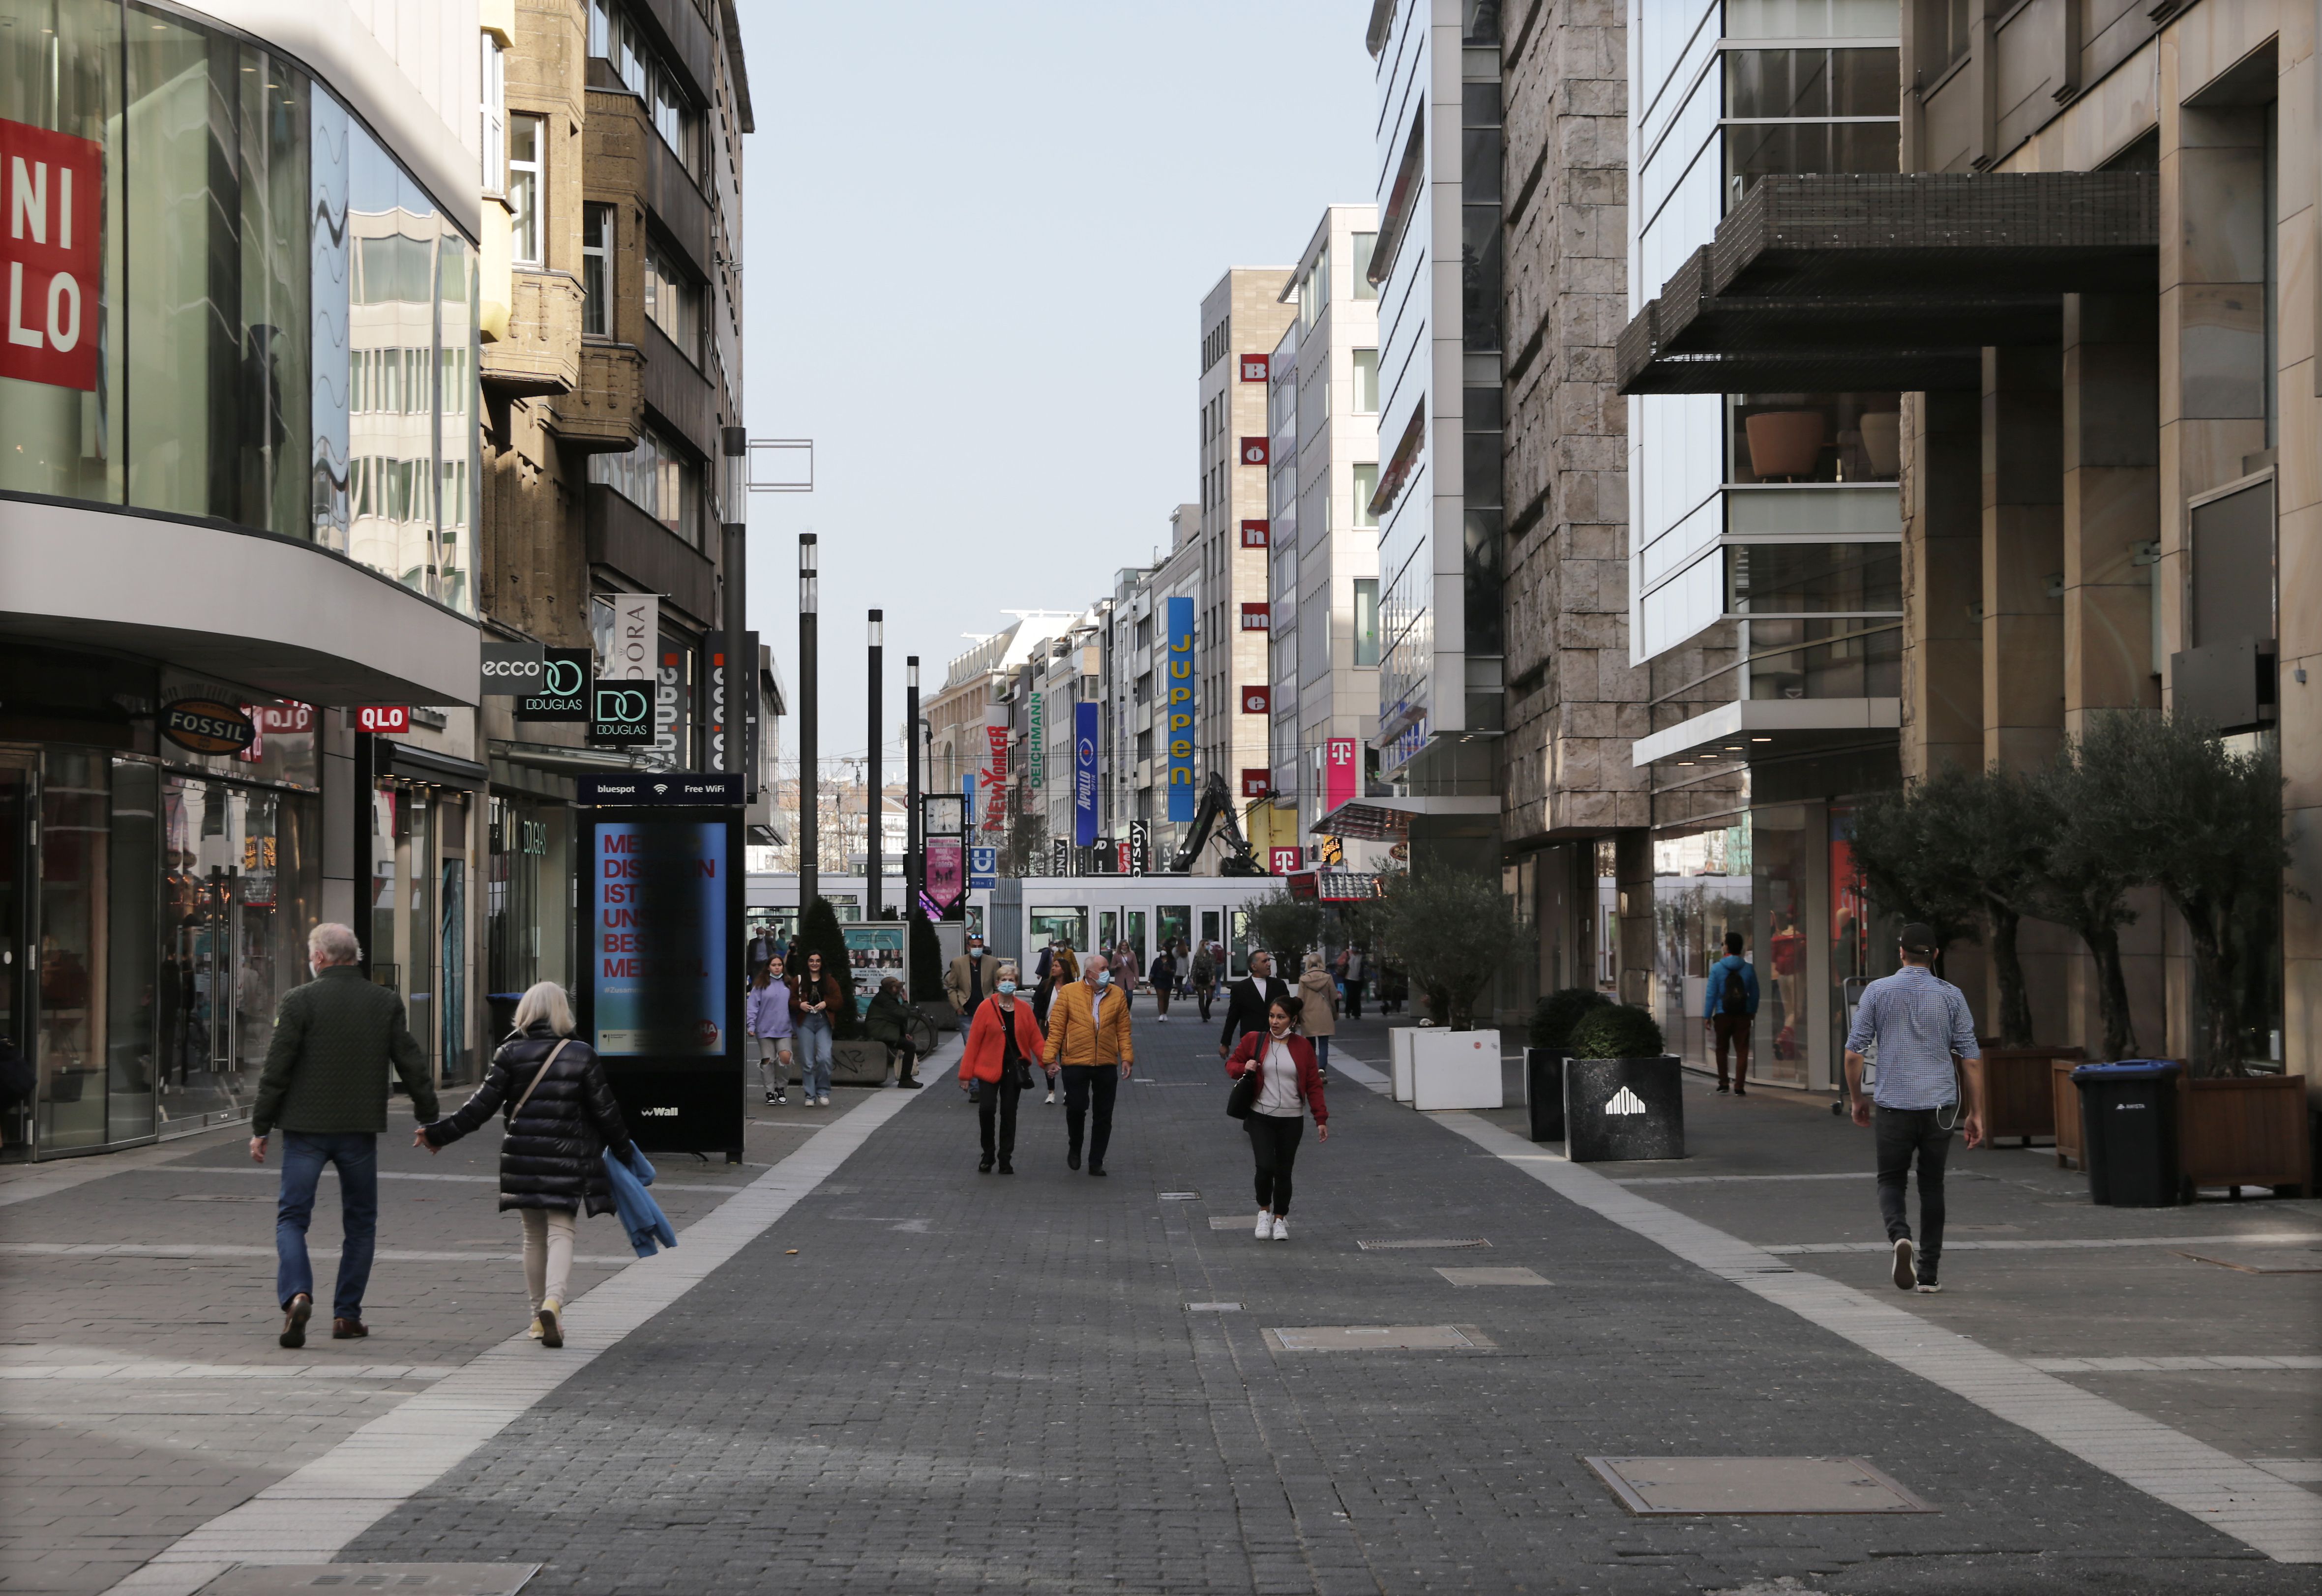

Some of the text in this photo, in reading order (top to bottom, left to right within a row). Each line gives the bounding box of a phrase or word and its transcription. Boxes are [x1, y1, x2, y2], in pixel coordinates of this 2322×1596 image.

[8, 261, 81, 353] LO
[482, 661, 540, 677] ecco
[526, 699, 583, 710] DOUGLAS
[170, 711, 244, 741] FOSSIL
[361, 708, 403, 729] QLO
[596, 724, 647, 736] DOUGLAS
[1031, 692, 1042, 789] DEICHMANN
[597, 785, 636, 795] bluespot
[1077, 770, 1091, 811] APOLLO
[1094, 840, 1107, 850] JD
[1132, 822, 1147, 878] orsay
[604, 884, 640, 903] IST
[653, 1107, 679, 1116] Wall
